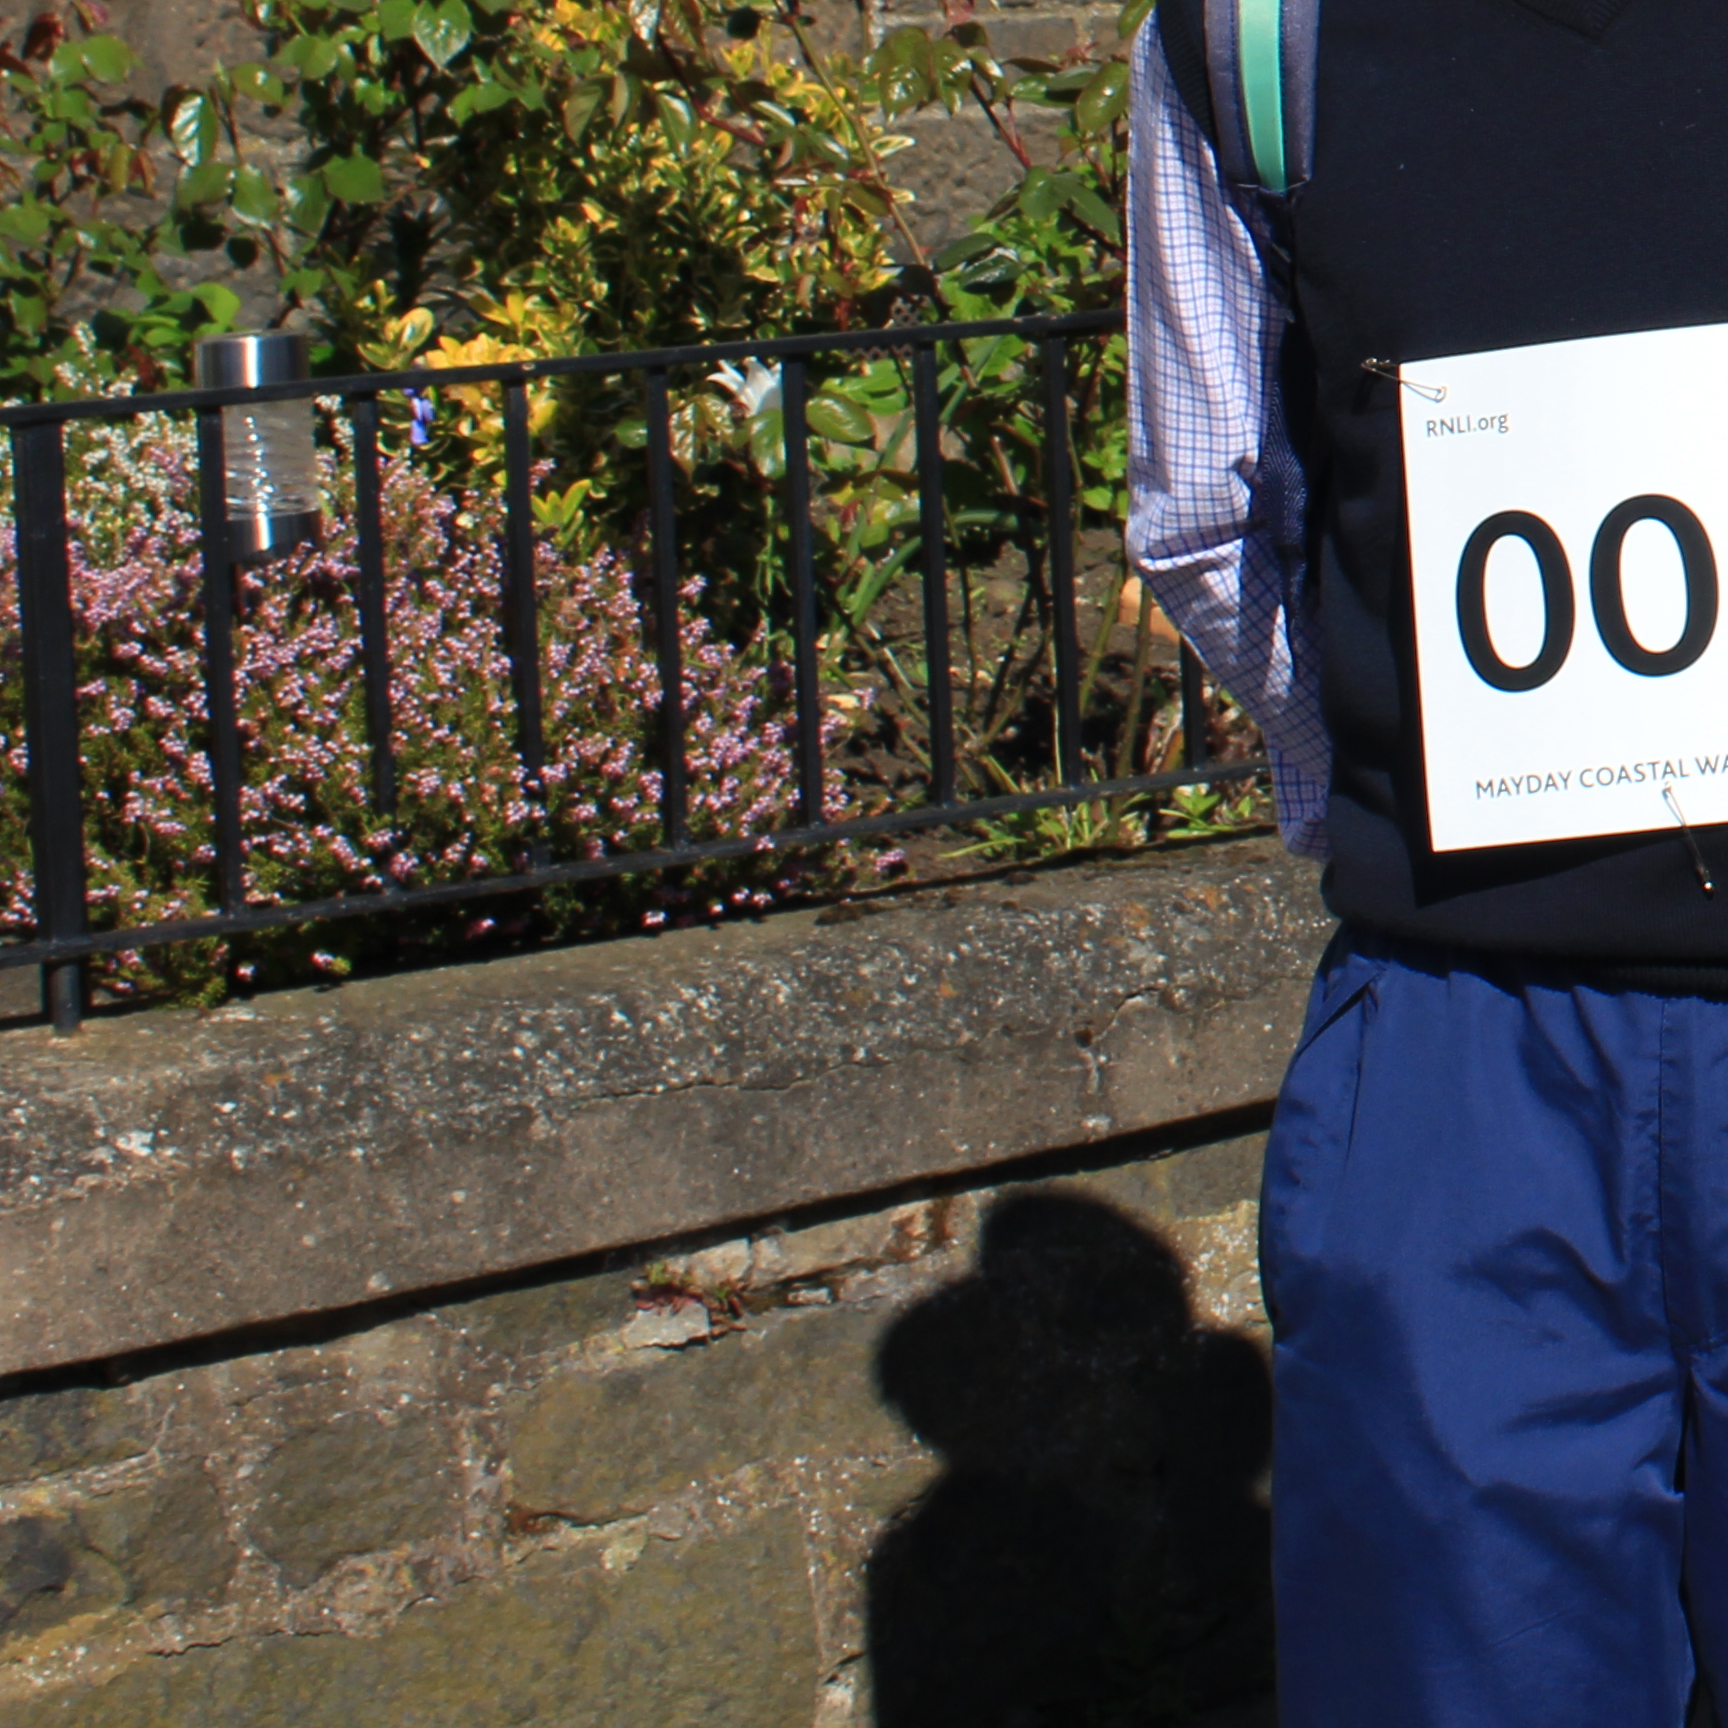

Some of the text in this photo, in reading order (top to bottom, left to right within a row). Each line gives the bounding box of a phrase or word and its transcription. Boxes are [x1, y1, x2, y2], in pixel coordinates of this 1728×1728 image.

[1426, 413, 1510, 438] RNLI.org
[1475, 771, 1572, 800] MAYDAY
[1579, 758, 1690, 788] COASTAL
